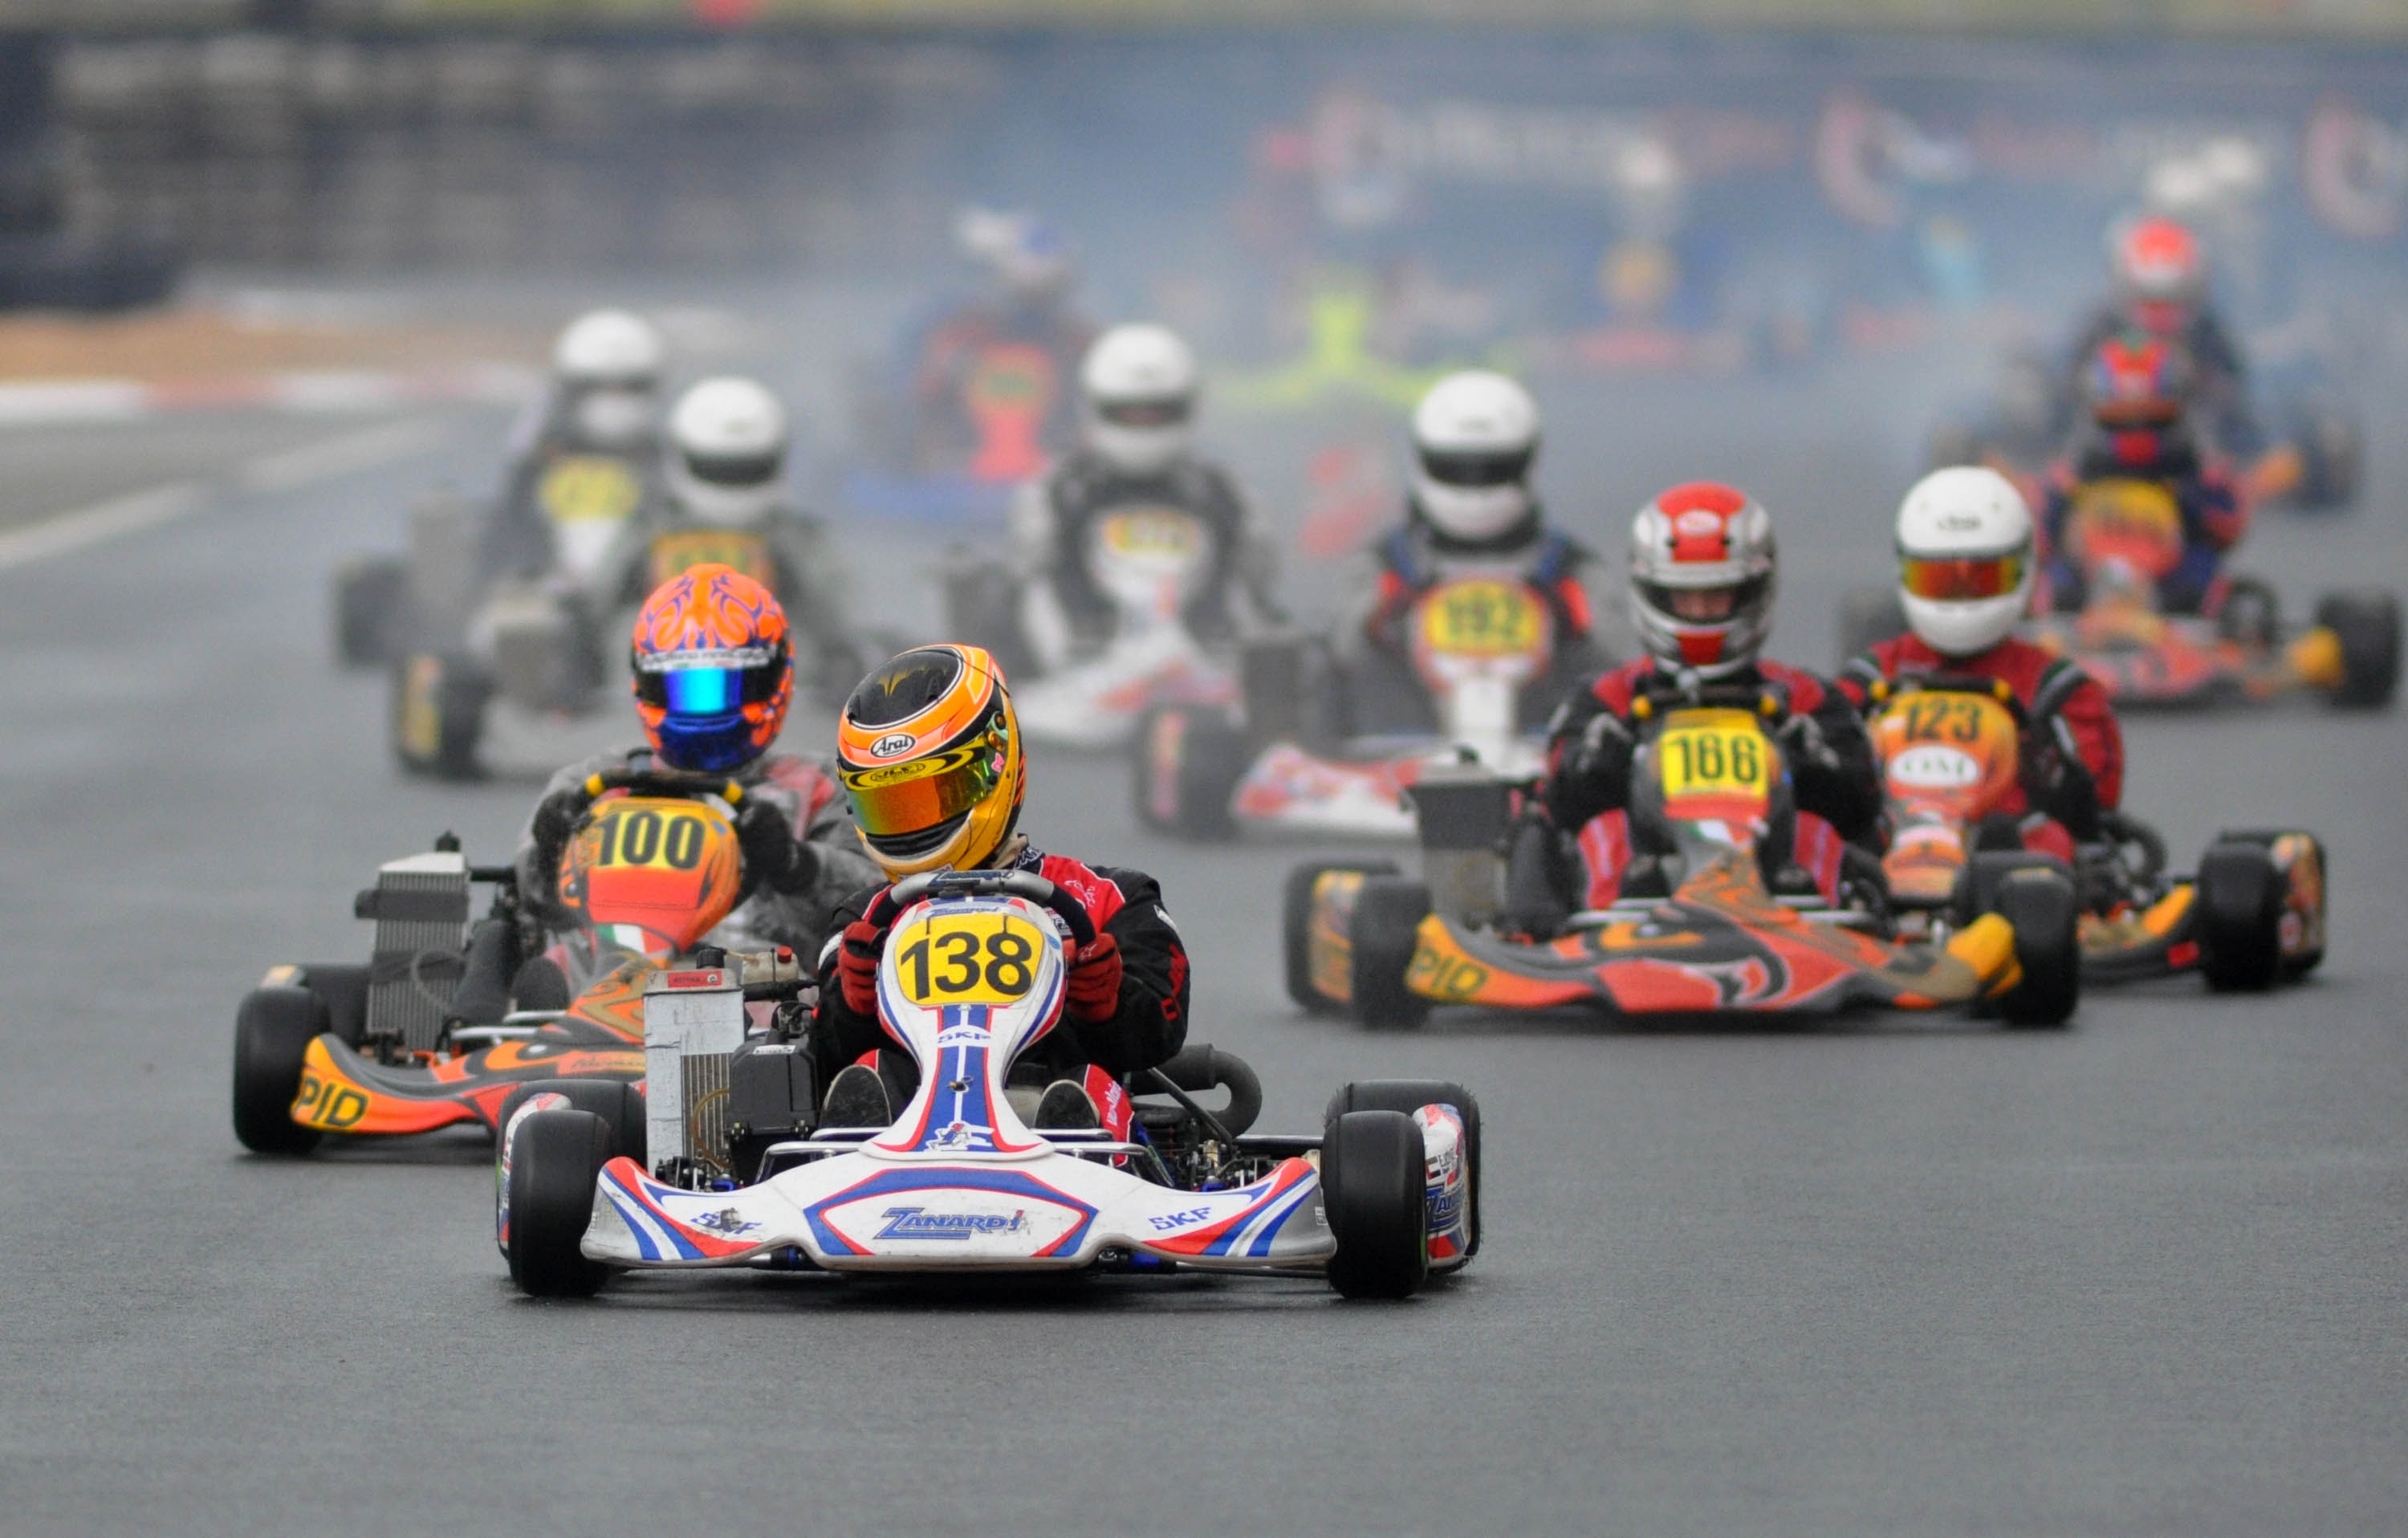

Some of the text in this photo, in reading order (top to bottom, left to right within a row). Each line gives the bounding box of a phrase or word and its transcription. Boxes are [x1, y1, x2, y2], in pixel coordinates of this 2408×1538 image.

[1905, 698, 1982, 743] 123
[873, 735, 909, 755] Arai
[1668, 734, 1759, 783] 166
[597, 810, 706, 871] 100
[901, 931, 1033, 1001] 138
[938, 1031, 991, 1044] SKF
[1147, 1206, 1211, 1231] SKF
